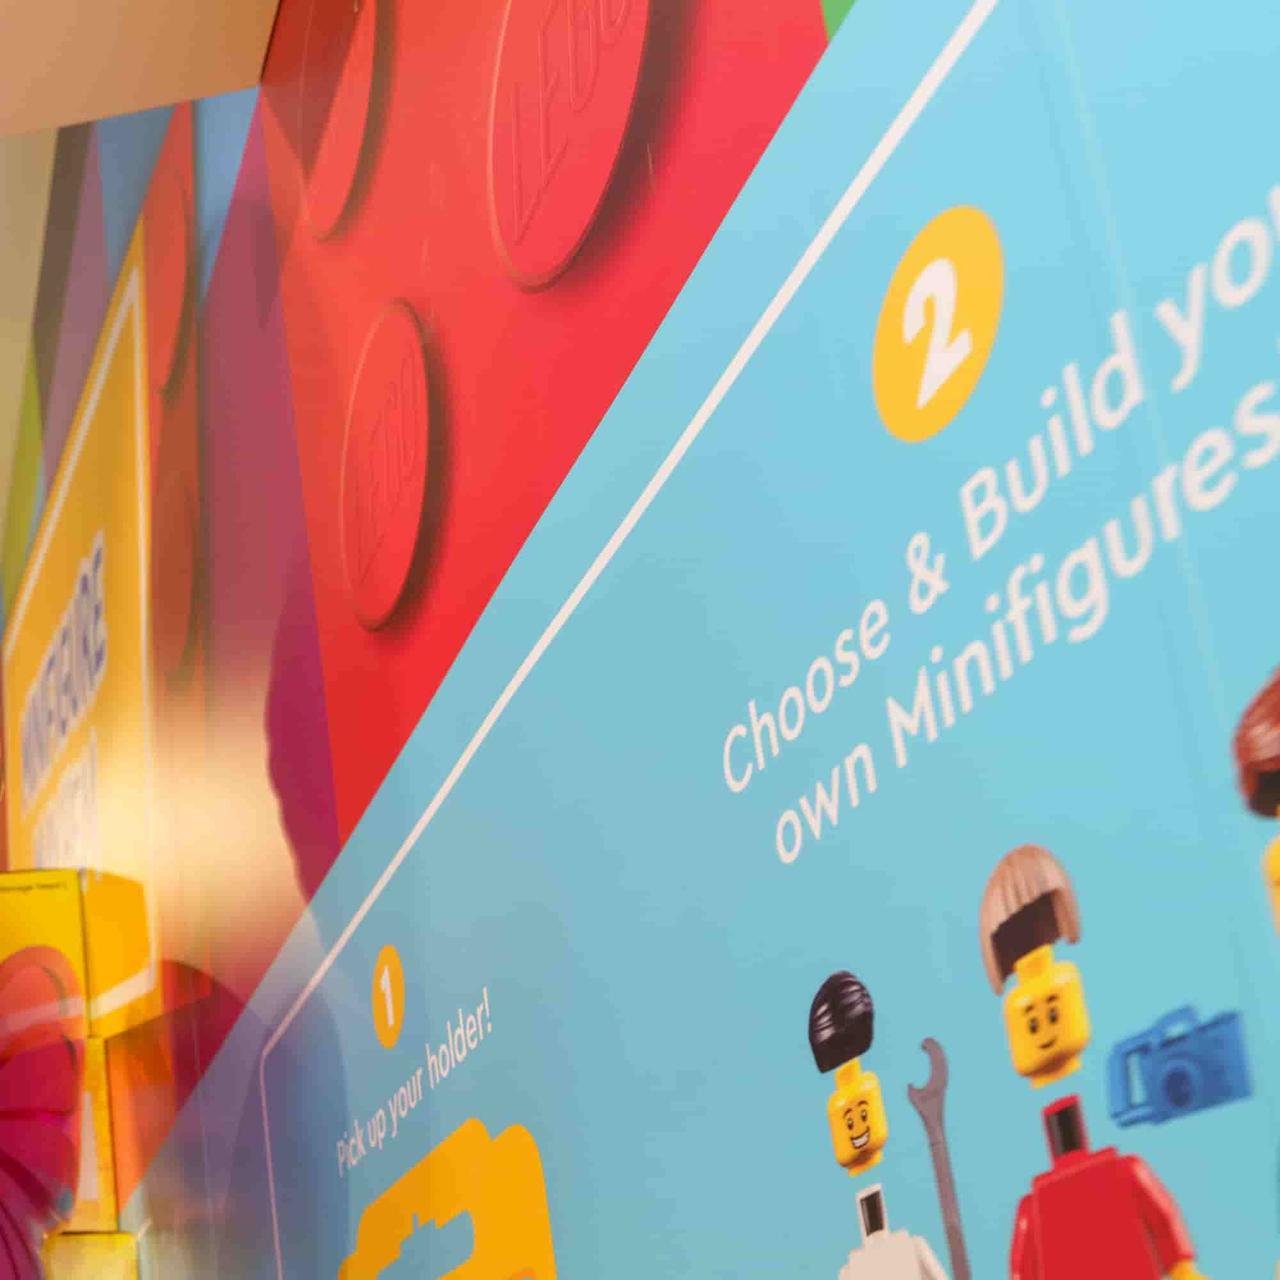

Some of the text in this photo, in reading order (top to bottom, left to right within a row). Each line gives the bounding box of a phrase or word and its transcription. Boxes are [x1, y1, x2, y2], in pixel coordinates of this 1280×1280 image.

[902, 257, 973, 410] 2
[722, 599, 891, 793] Choose
[905, 532, 950, 614] &
[959, 308, 1144, 560] Build
[775, 381, 1280, 864] own Minifigures
[336, 986, 492, 1178] Pick up your holder!
[379, 965, 395, 1026] 1
